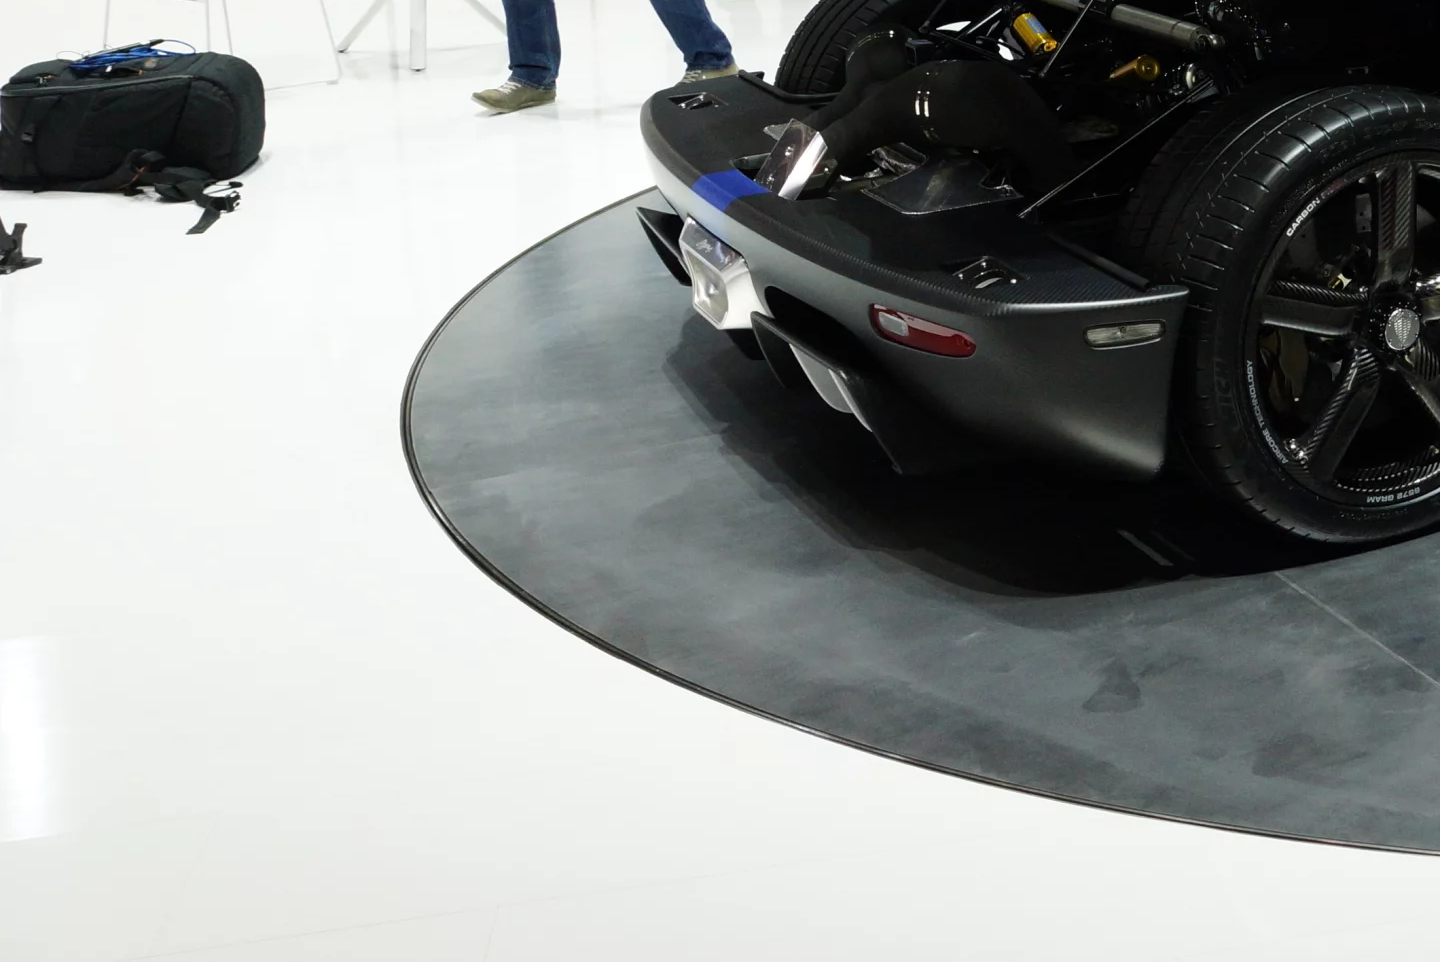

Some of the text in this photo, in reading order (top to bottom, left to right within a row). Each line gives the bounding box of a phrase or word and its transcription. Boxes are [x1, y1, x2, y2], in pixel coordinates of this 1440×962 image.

[1286, 195, 1320, 237] CARBON
[1246, 359, 1289, 464] AIRCORE TECHNOLOGY
[1366, 494, 1395, 504] GRAM
